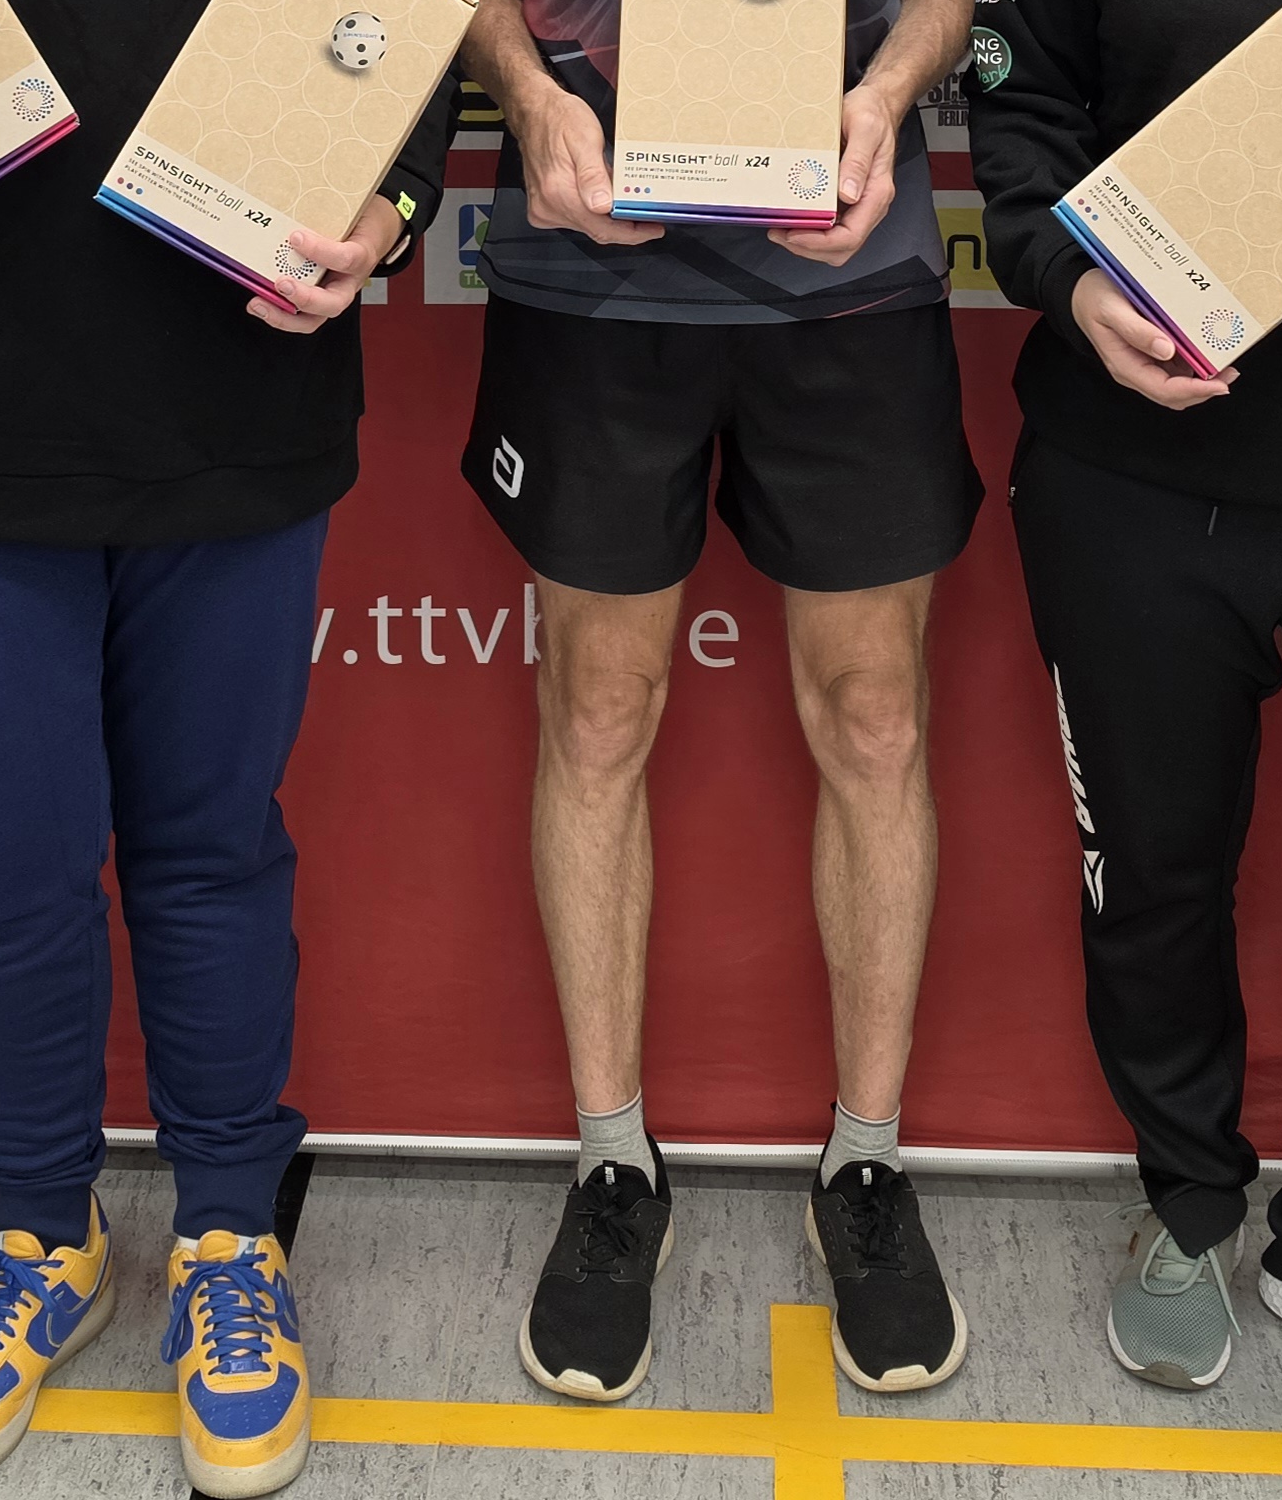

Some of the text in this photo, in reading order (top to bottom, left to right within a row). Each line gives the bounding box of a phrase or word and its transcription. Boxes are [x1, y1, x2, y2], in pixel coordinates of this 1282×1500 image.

[714, 154, 738, 167] ball
[745, 156, 770, 168] x24
[217, 190, 244, 212] ball
[244, 208, 272, 228] x24
[1164, 243, 1189, 266] ball
[1186, 269, 1212, 292] x24
